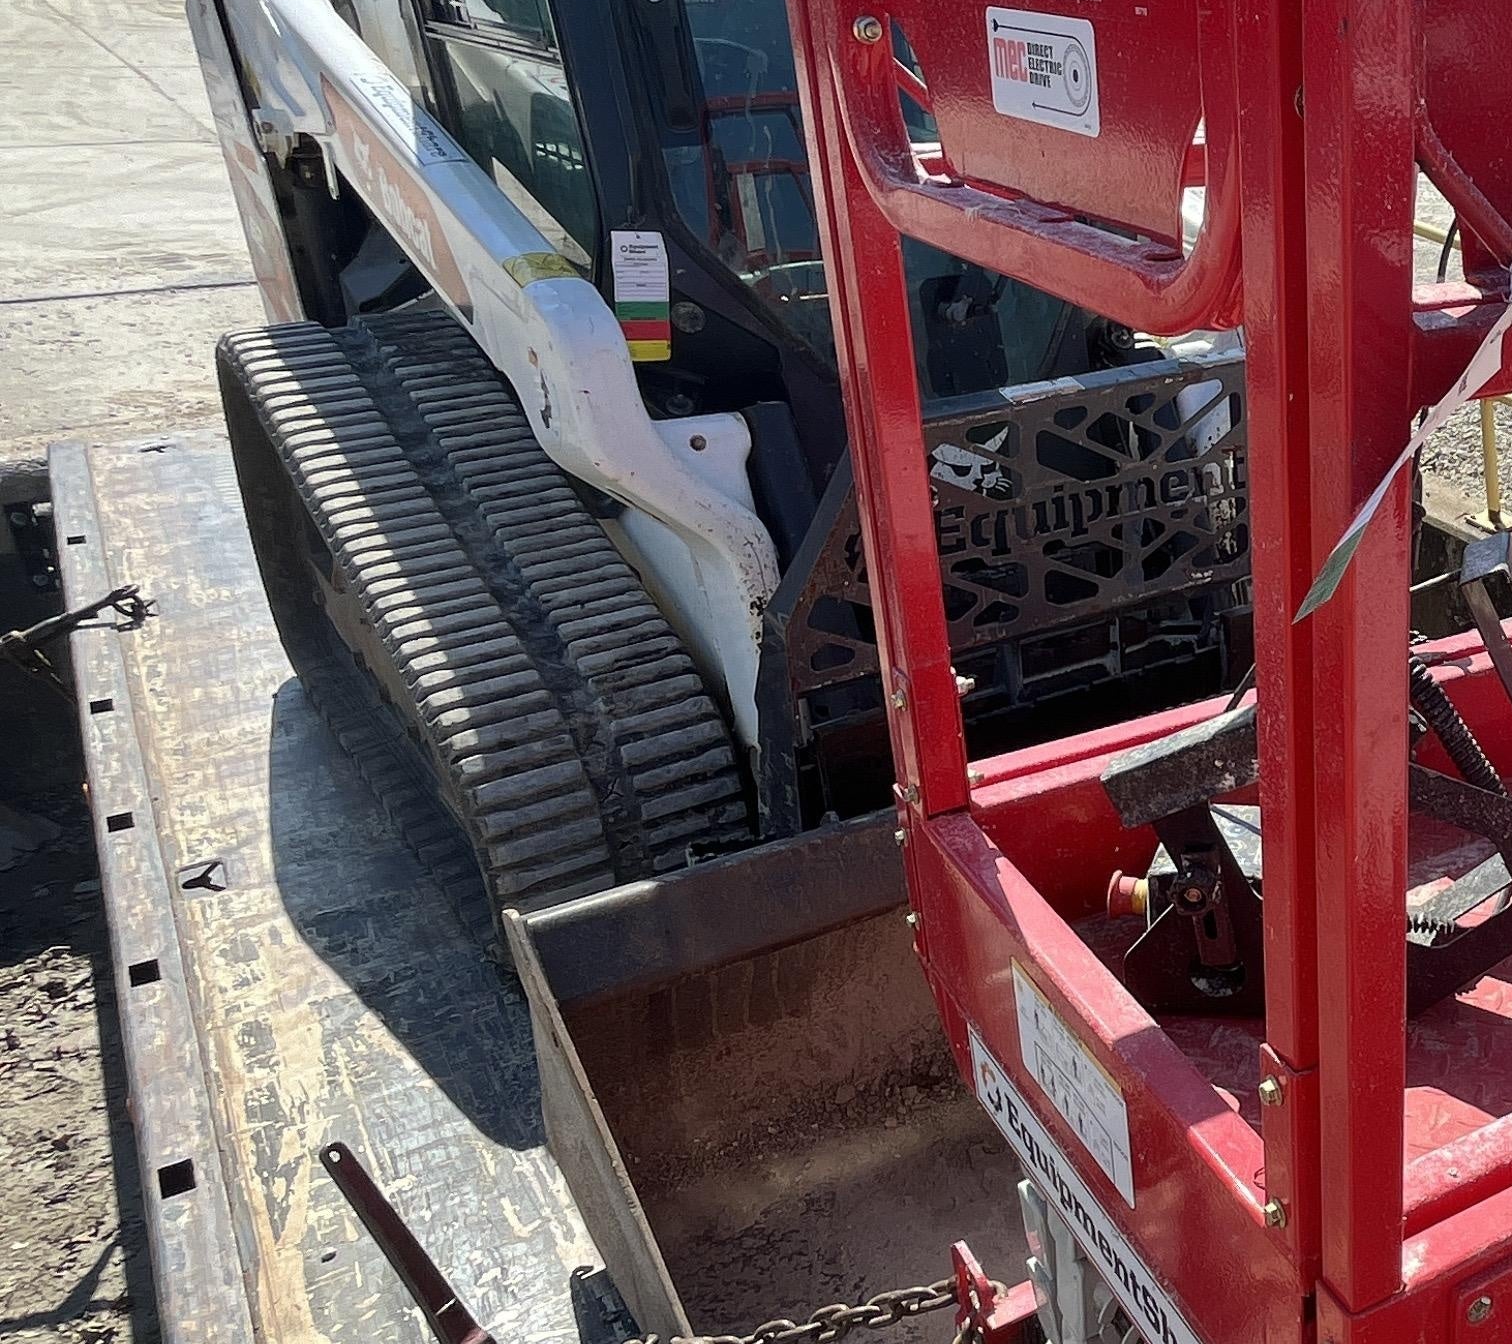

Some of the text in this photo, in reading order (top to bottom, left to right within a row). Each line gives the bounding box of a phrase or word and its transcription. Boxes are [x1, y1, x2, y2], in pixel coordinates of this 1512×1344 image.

[1026, 42, 1053, 59] DIRECT
[1028, 58, 1063, 76] ELECTRIC
[1029, 72, 1051, 88] DRIVE
